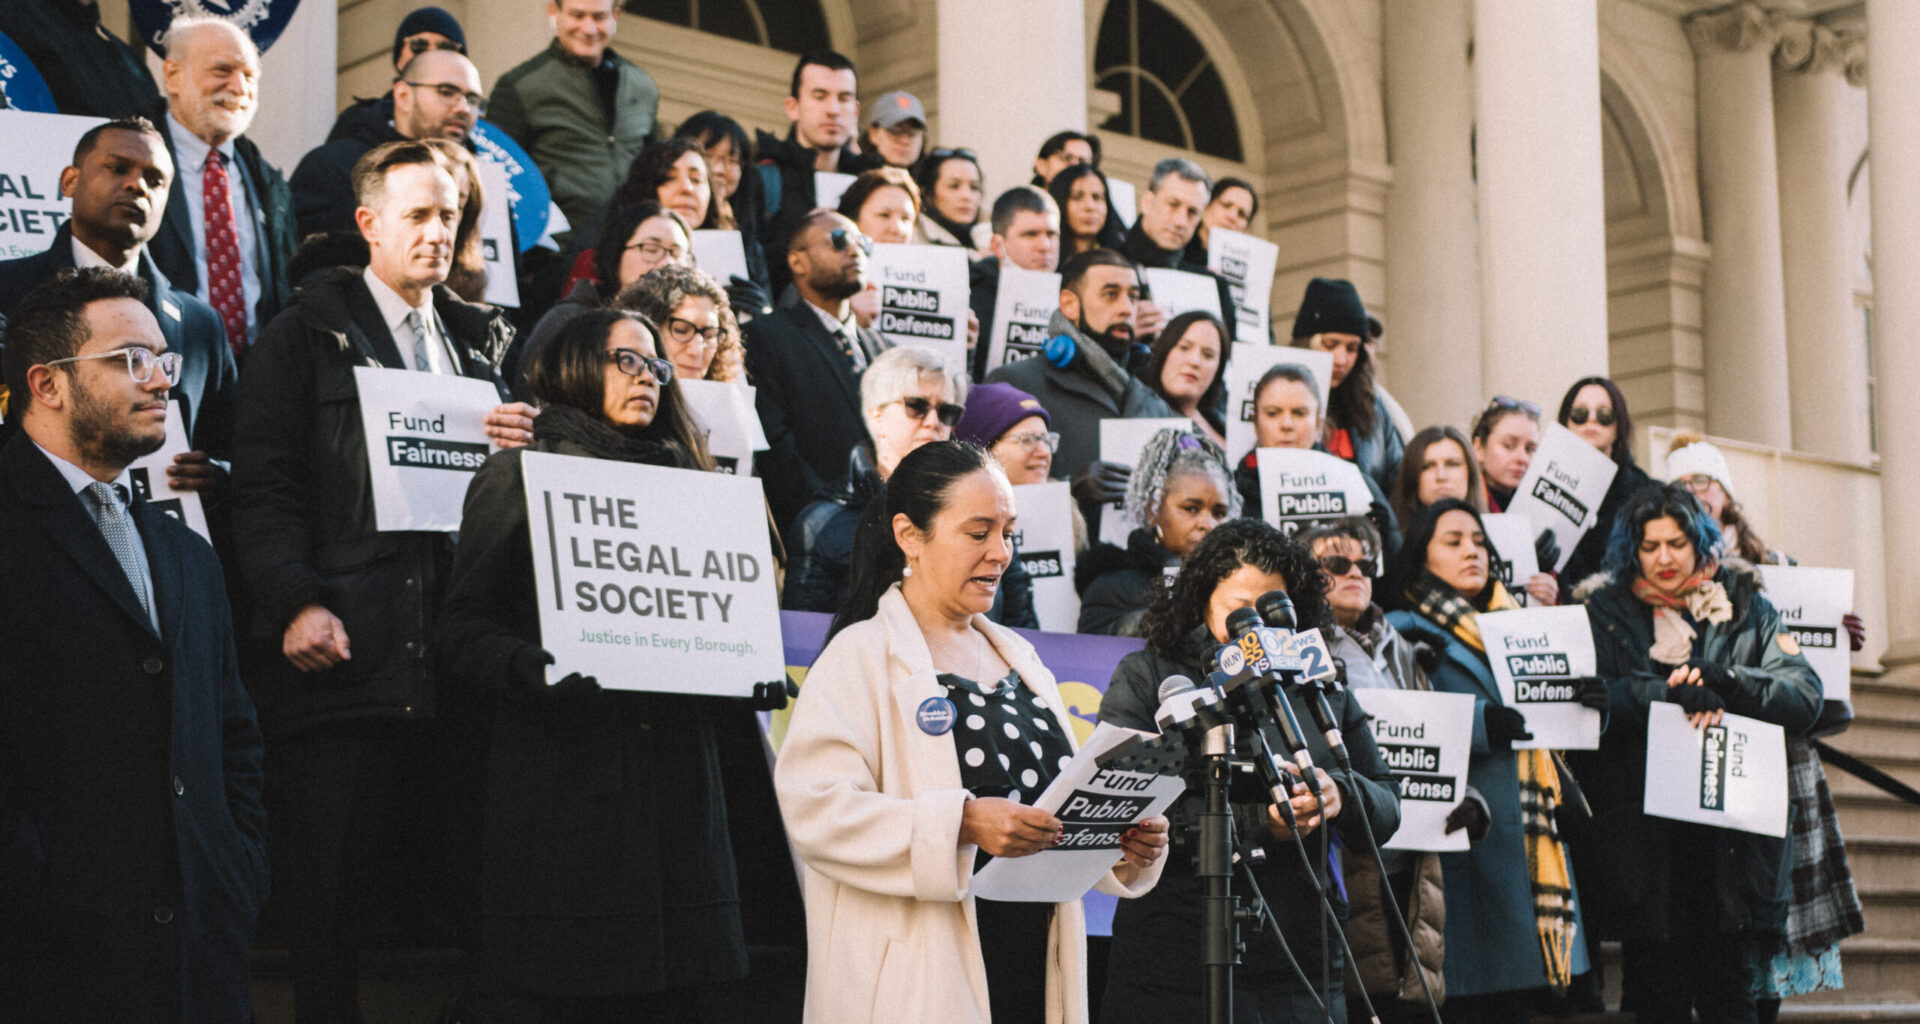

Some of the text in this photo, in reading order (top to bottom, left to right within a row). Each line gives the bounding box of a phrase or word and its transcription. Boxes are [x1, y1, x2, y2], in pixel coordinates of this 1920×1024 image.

[885, 266, 926, 283] Fund
[884, 287, 938, 311] Public
[882, 312, 952, 338] Defense
[388, 411, 445, 433] Fund
[1280, 472, 1327, 488] Fund
[1546, 461, 1580, 490] Fund
[563, 492, 639, 530] THE
[1281, 493, 1343, 515] Public
[1535, 481, 1585, 520] Fairness
[570, 536, 760, 583] LEGAL AID
[575, 581, 733, 623] SOCIETY
[1780, 606, 1802, 620] nd
[579, 628, 758, 657] Justice in Every Borough.
[1504, 632, 1550, 650] Fund
[1790, 631, 1833, 647] ness
[1300, 646, 1330, 677] 2
[1508, 654, 1567, 675] Public
[1516, 681, 1576, 701] Defens
[1376, 720, 1425, 739] Fund
[1377, 746, 1436, 769] Public
[1731, 731, 1748, 779] Fund
[1088, 767, 1160, 792] Fund
[1703, 727, 1725, 808] Fairness
[1400, 776, 1453, 800] fense
[1062, 795, 1139, 819] Public
[1057, 828, 1122, 846] efens
